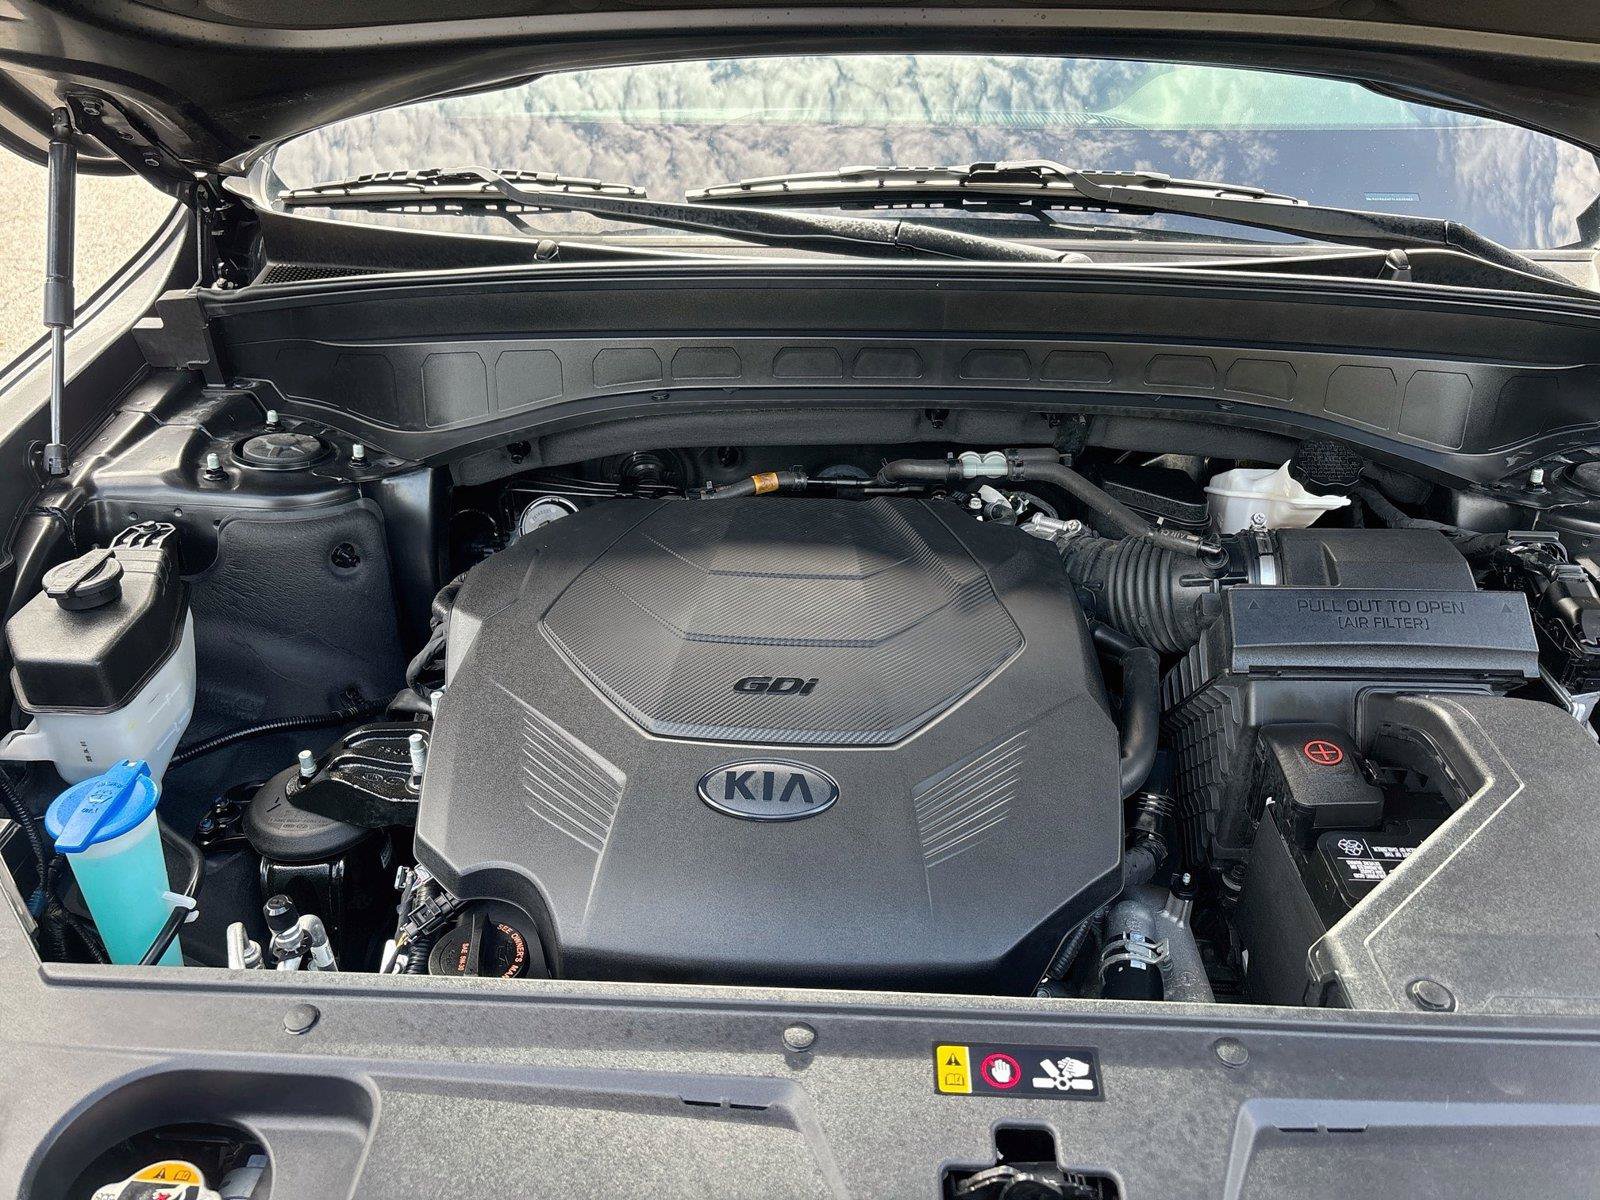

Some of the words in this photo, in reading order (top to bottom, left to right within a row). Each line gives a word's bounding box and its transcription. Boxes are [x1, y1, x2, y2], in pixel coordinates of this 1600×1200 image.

[1297, 599, 1342, 613] PULL
[1346, 599, 1381, 613] OUT
[1389, 599, 1411, 613] TO
[1416, 600, 1466, 615] OPEN
[724, 770, 815, 804] KIA
[497, 923, 513, 935] SEE
